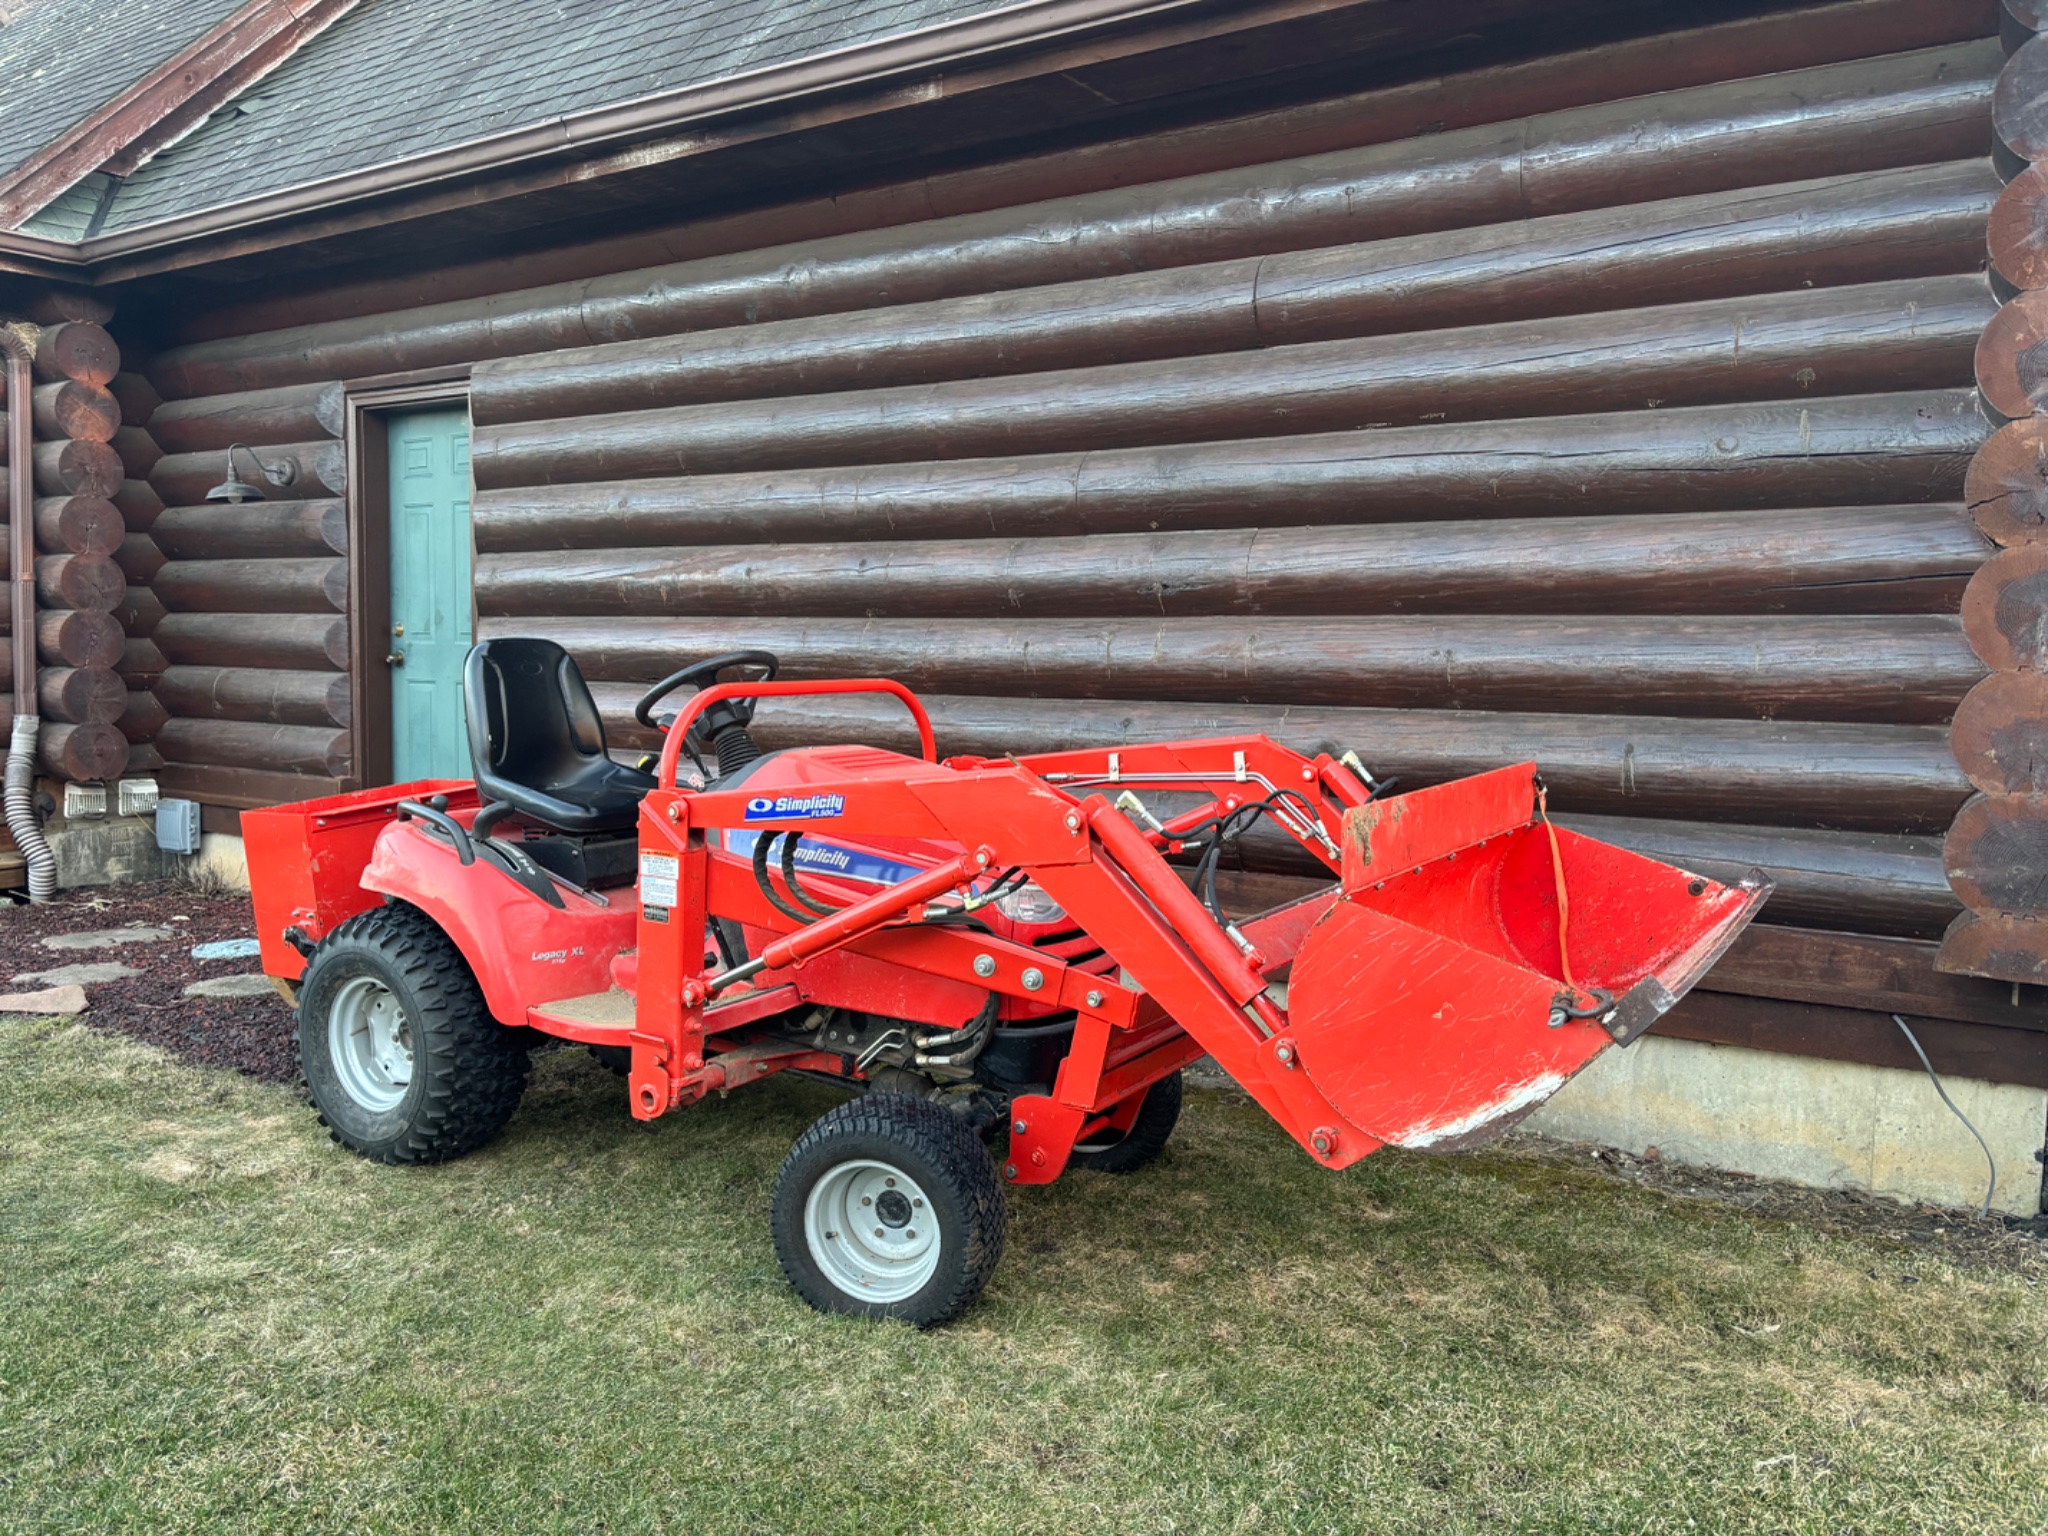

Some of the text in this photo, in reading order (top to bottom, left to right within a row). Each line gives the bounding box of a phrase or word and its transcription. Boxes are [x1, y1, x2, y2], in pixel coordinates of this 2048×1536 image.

[775, 793, 844, 813] Simplicity
[778, 842, 850, 869] mplicity
[531, 946, 585, 961] Legacy XL
